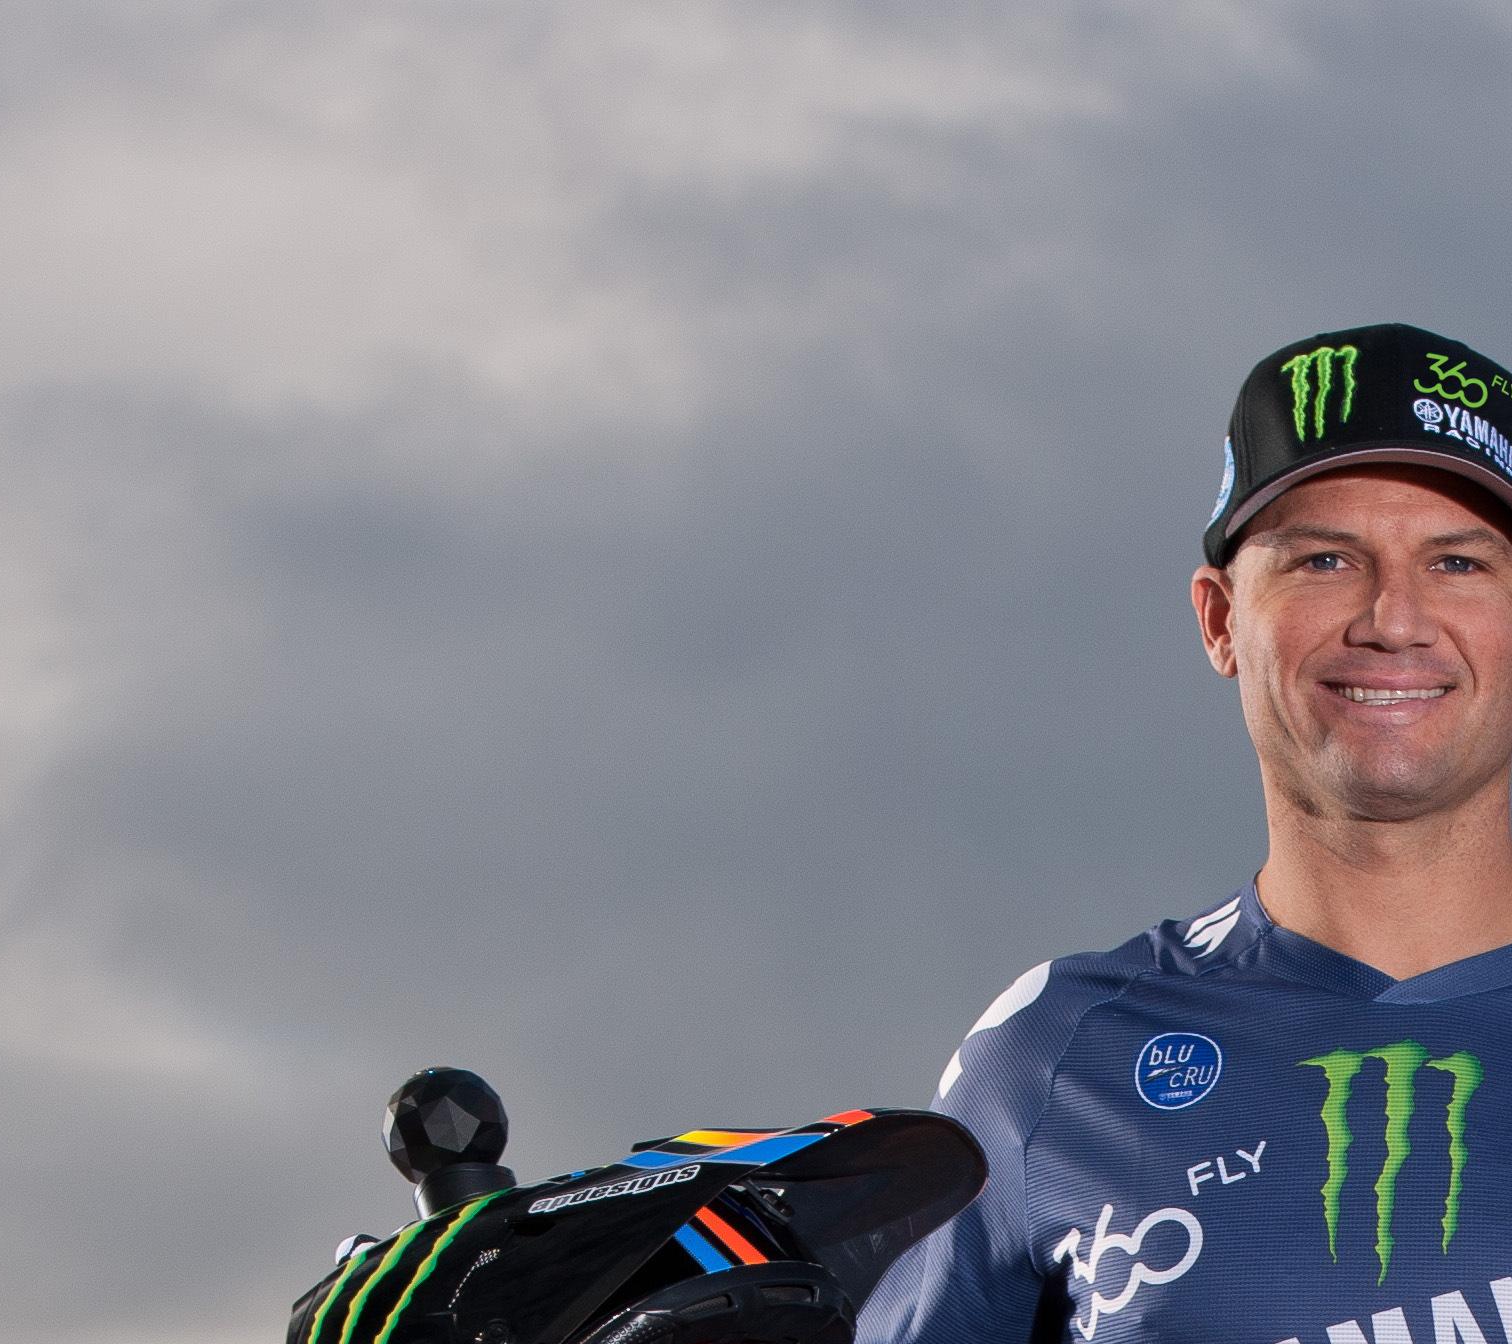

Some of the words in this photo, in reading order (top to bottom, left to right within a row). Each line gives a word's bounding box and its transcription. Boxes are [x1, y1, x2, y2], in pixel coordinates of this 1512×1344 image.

[1413, 352, 1489, 408] 360
[1186, 1140, 1268, 1197] FLY
[1054, 1202, 1203, 1341] 360
